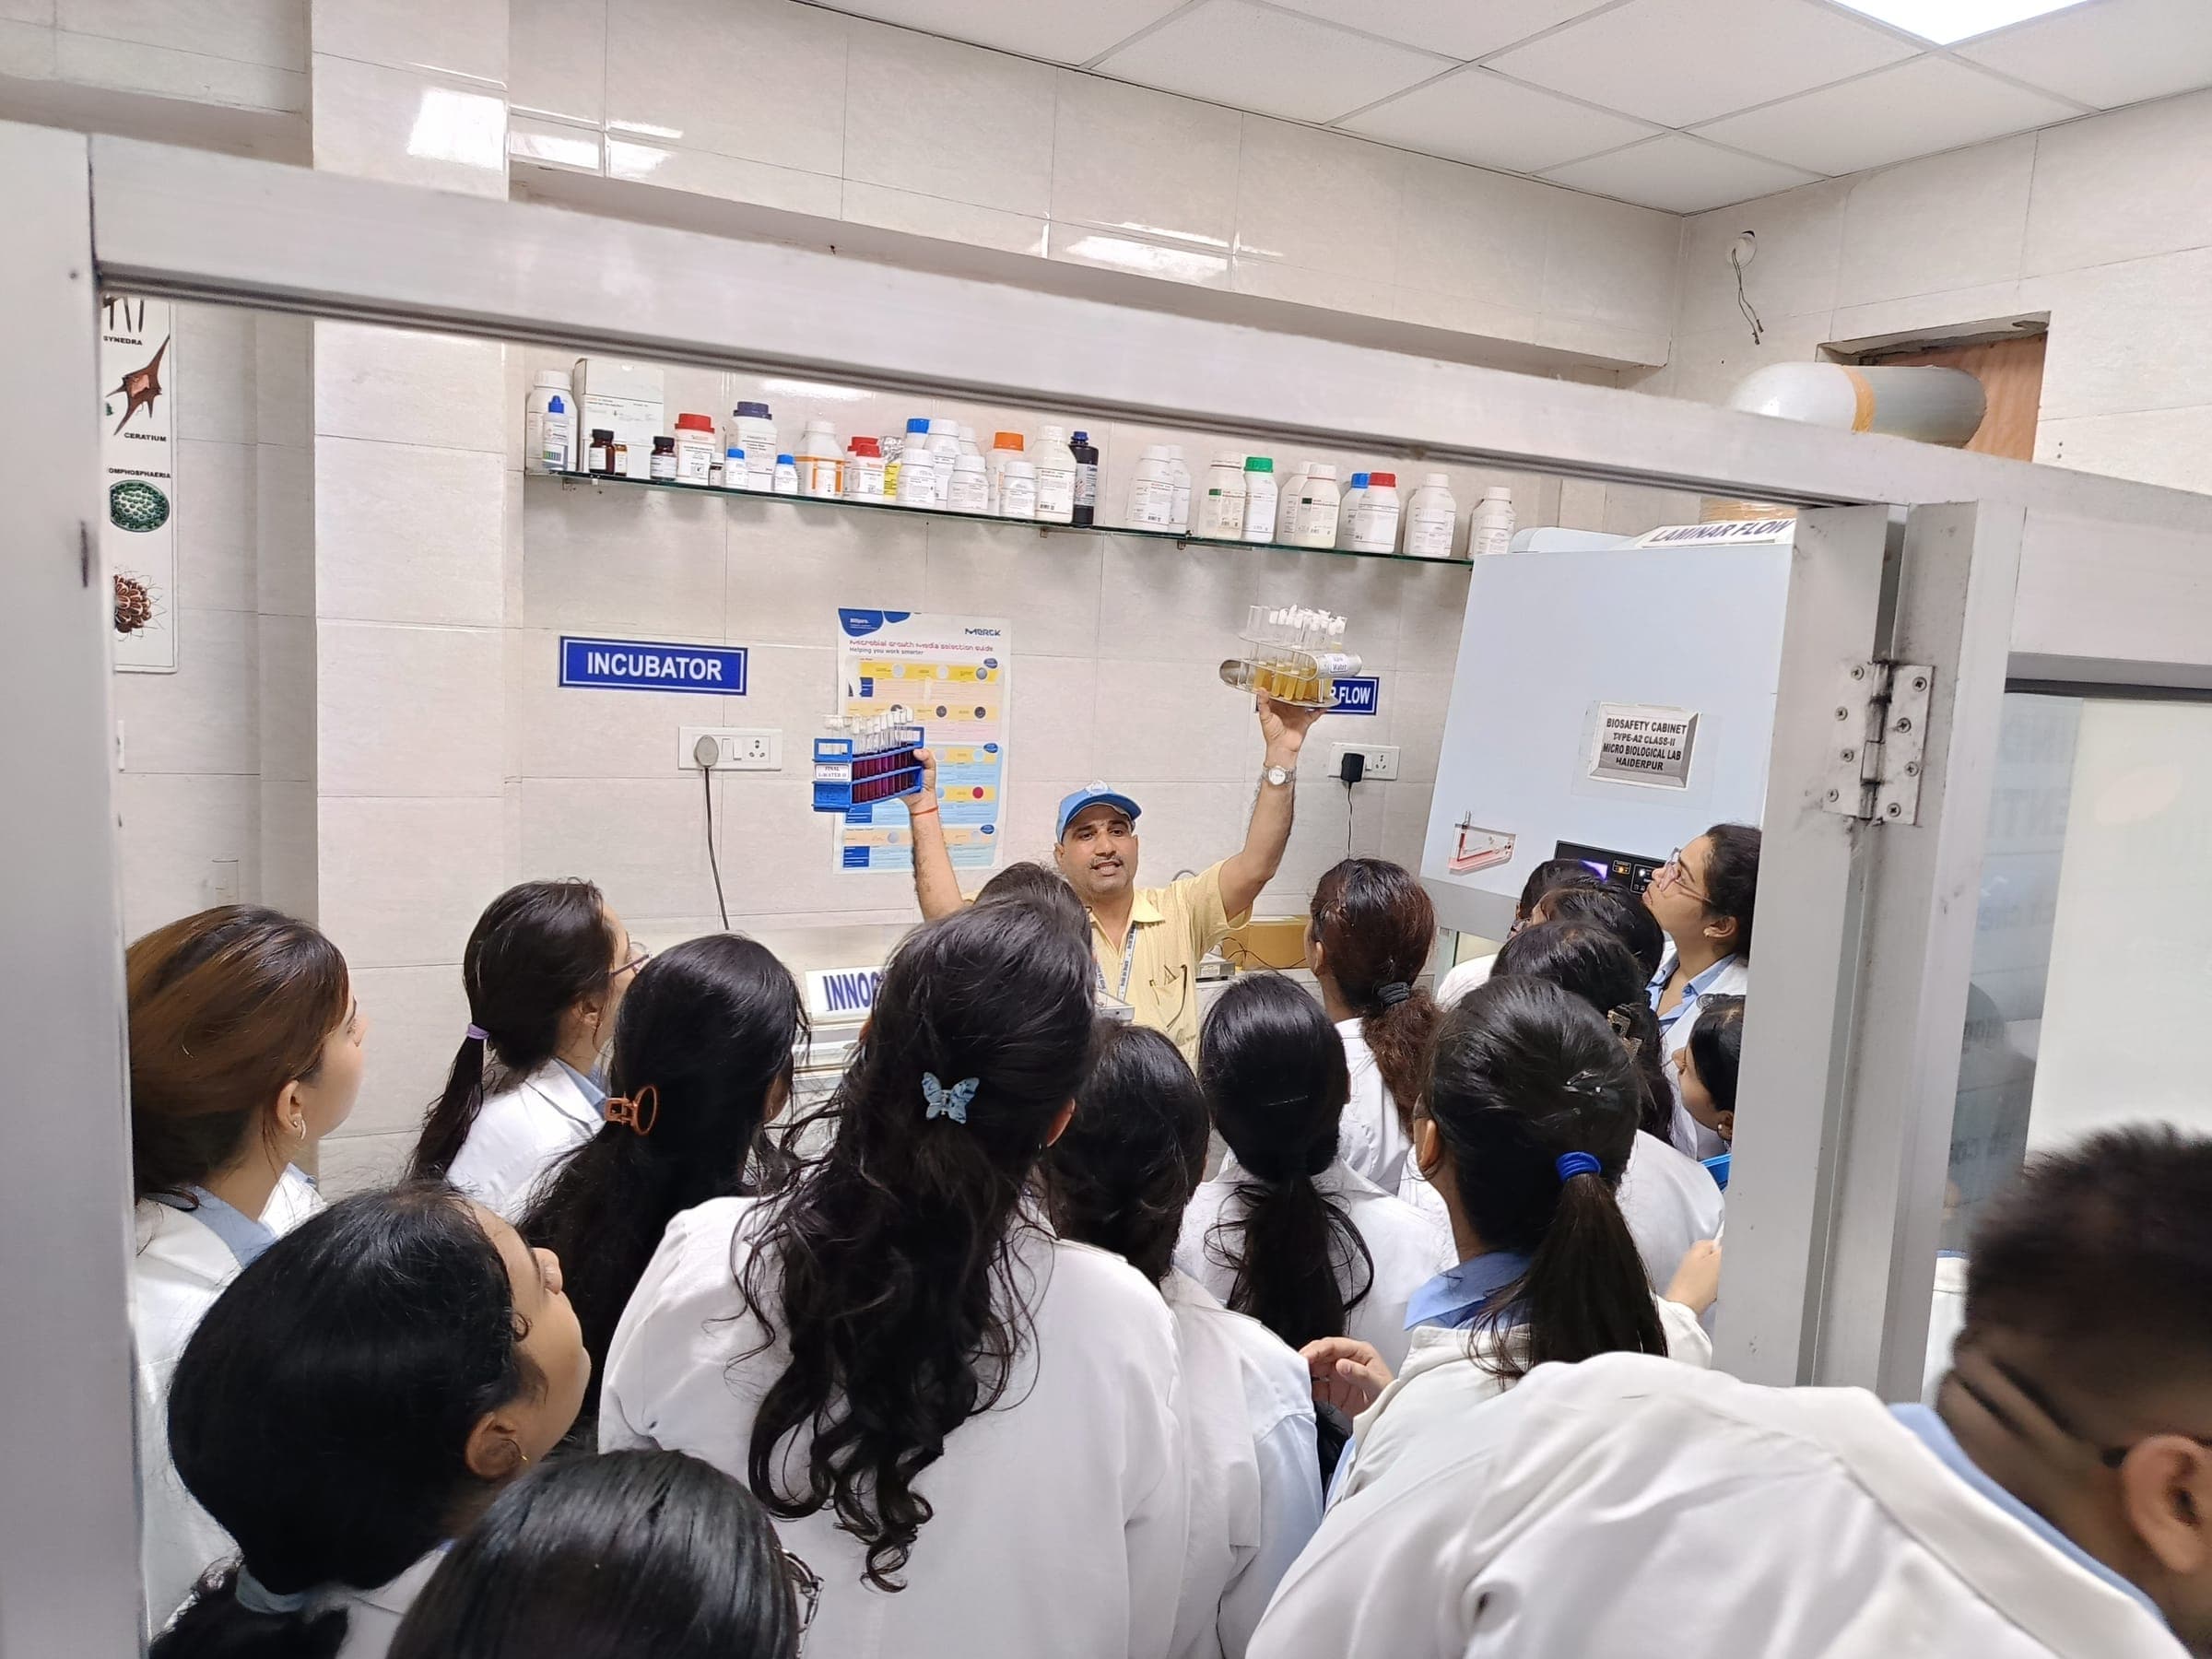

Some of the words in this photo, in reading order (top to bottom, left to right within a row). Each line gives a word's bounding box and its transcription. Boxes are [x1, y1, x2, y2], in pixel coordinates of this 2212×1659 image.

[103, 335, 143, 346] SYNEDRA
[124, 432, 167, 442] CERATIUM
[1650, 524, 1737, 542] LAMINAR
[1731, 520, 1795, 536] FLOW
[587, 652, 723, 681] INCUBATOR
[1339, 686, 1371, 704] FLOW
[1606, 718, 1650, 731] BIOSAFETY
[1652, 722, 1688, 735] CABINET
[1613, 732, 1643, 743] TYPE-A2
[1644, 735, 1676, 747] CLASS-II
[1603, 743, 1624, 754] MICRO
[1625, 745, 1665, 759] BIOLOGICAL
[1667, 749, 1682, 760] LAB
[1616, 757, 1664, 771] HAIDERPUR
